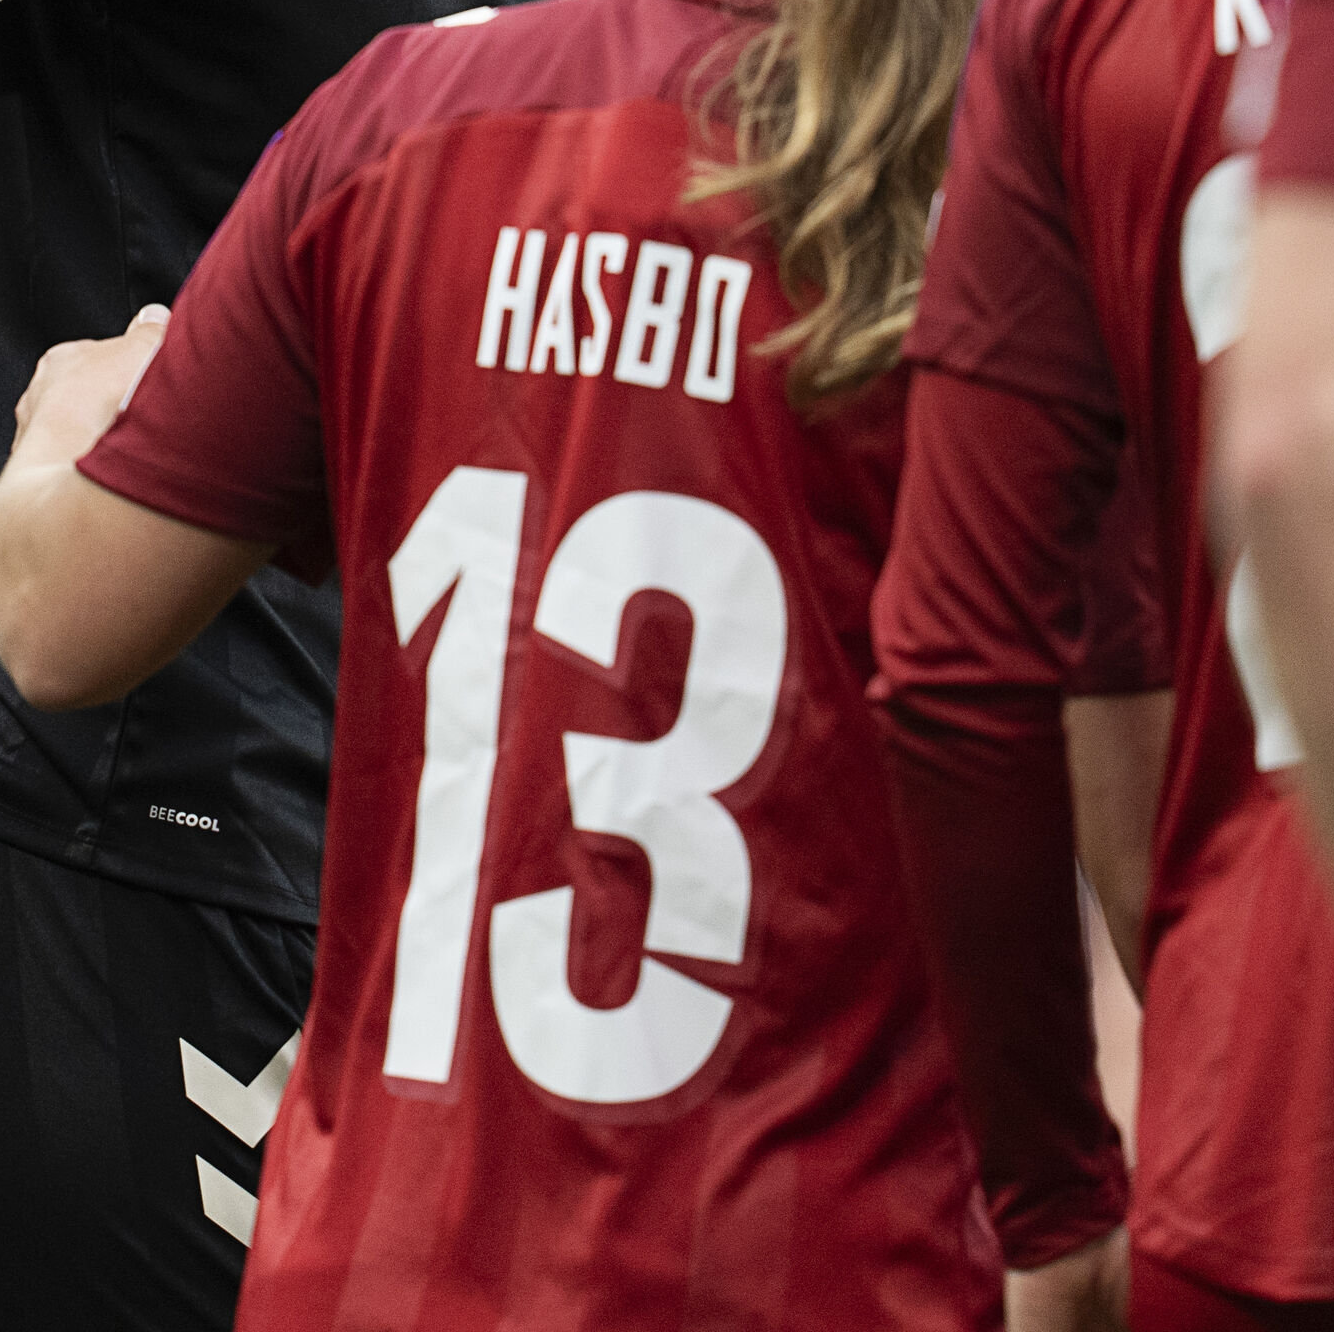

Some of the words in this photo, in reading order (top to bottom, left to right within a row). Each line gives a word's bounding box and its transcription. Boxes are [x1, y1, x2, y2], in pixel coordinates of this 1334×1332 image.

[476, 226, 753, 404] HASBO
[149, 804, 220, 833] BEECOOL
[383, 465, 789, 1104] 13
